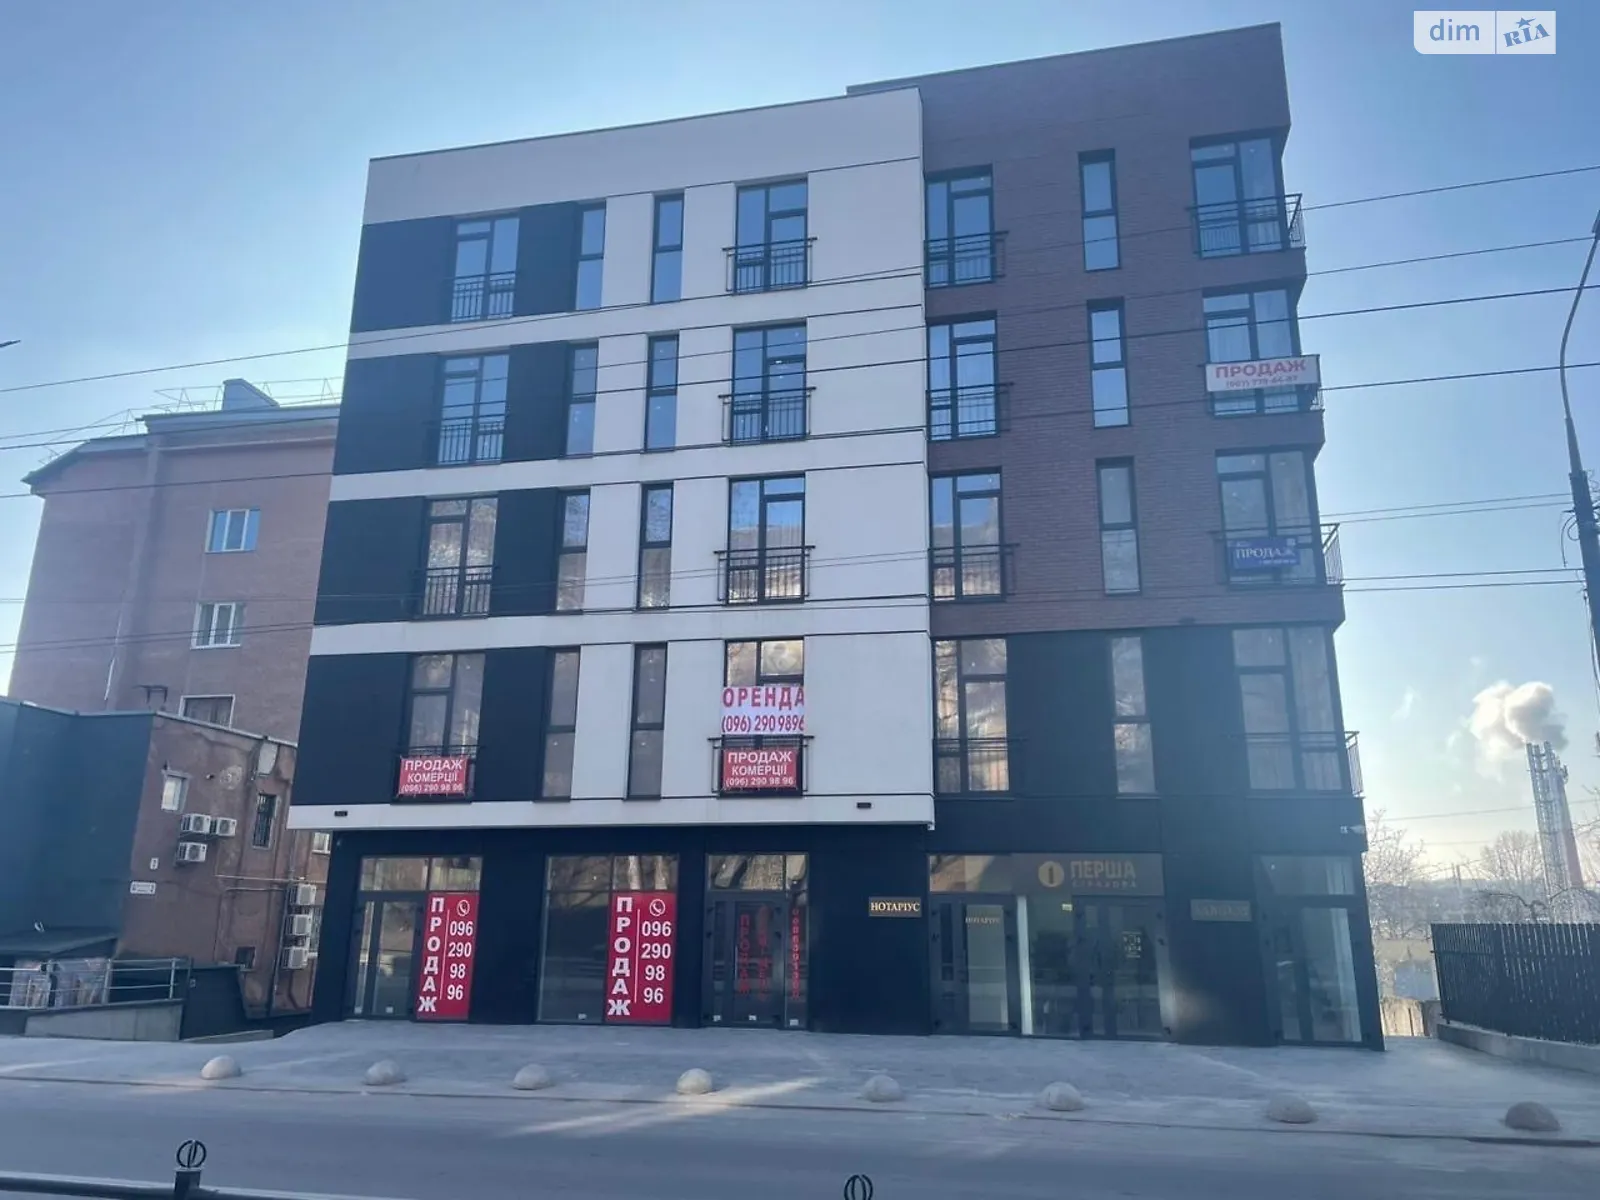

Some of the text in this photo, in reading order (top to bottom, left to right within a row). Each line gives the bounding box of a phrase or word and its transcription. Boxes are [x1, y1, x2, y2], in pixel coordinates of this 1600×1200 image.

[1215, 359, 1307, 379] ПРОДАЖ
[722, 687, 804, 711] ОРЕНДА
[721, 714, 751, 733] (096)
[754, 714, 776, 732] 290
[404, 759, 463, 771] ПРОДАЖ
[728, 751, 792, 765] ПРОДАЖ
[407, 770, 458, 783] КОМЕРЦІЇ
[731, 764, 787, 777] КОМЕРЦІЇ
[424, 783, 438, 791] 290
[726, 776, 794, 787] (096) 290 98 96
[1070, 859, 1137, 879] ПЕРША
[870, 901, 921, 912] НОТАРІУС
[449, 920, 474, 937] 096
[641, 920, 672, 937] 096
[418, 896, 445, 1013] ПРОДАЖ
[448, 941, 472, 958] 290
[607, 896, 633, 1016] ПРОДАЖ
[640, 943, 672, 960] 290
[449, 963, 466, 979] 98
[645, 965, 665, 981] 98
[447, 984, 464, 1001] 96
[643, 987, 664, 1004] 96
